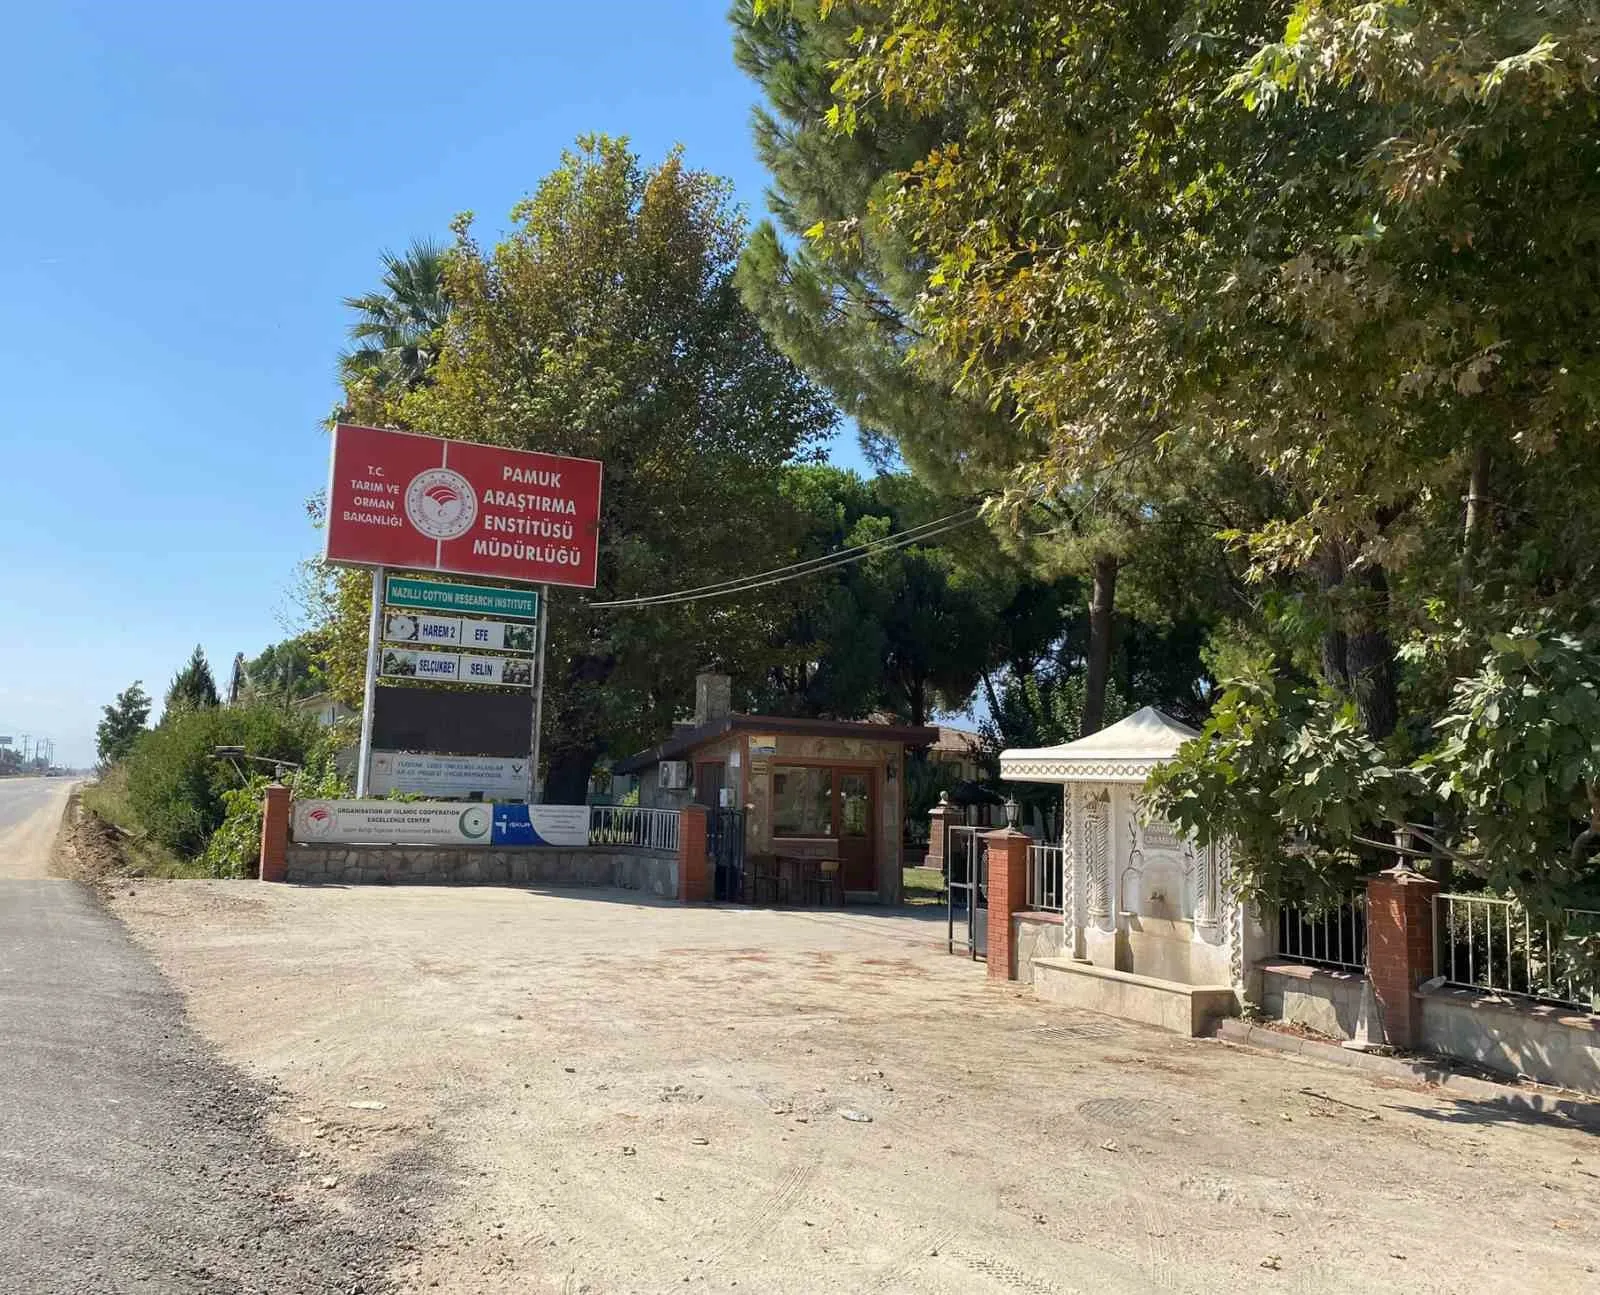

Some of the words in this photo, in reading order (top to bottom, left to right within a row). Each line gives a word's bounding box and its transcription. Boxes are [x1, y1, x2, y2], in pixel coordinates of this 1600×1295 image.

[367, 465, 385, 477] T.C.
[503, 466, 561, 488] PAMUK
[351, 480, 384, 493] TARIM
[386, 484, 400, 495] VE
[353, 496, 395, 511] ORMAN
[483, 489, 577, 515] ARAŞTIRMA
[343, 511, 403, 527] BAKANLIĞI
[484, 514, 573, 540] ENSTİTÜSÜ
[473, 537, 581, 566] MÜDÜRLÜĞÜ
[422, 590, 453, 603] COTTON
[455, 593, 493, 608] RESEARCH
[495, 597, 533, 611] INSTITUTE
[422, 624, 450, 638] HAREM
[450, 628, 456, 639] 2
[475, 629, 489, 642] EFE
